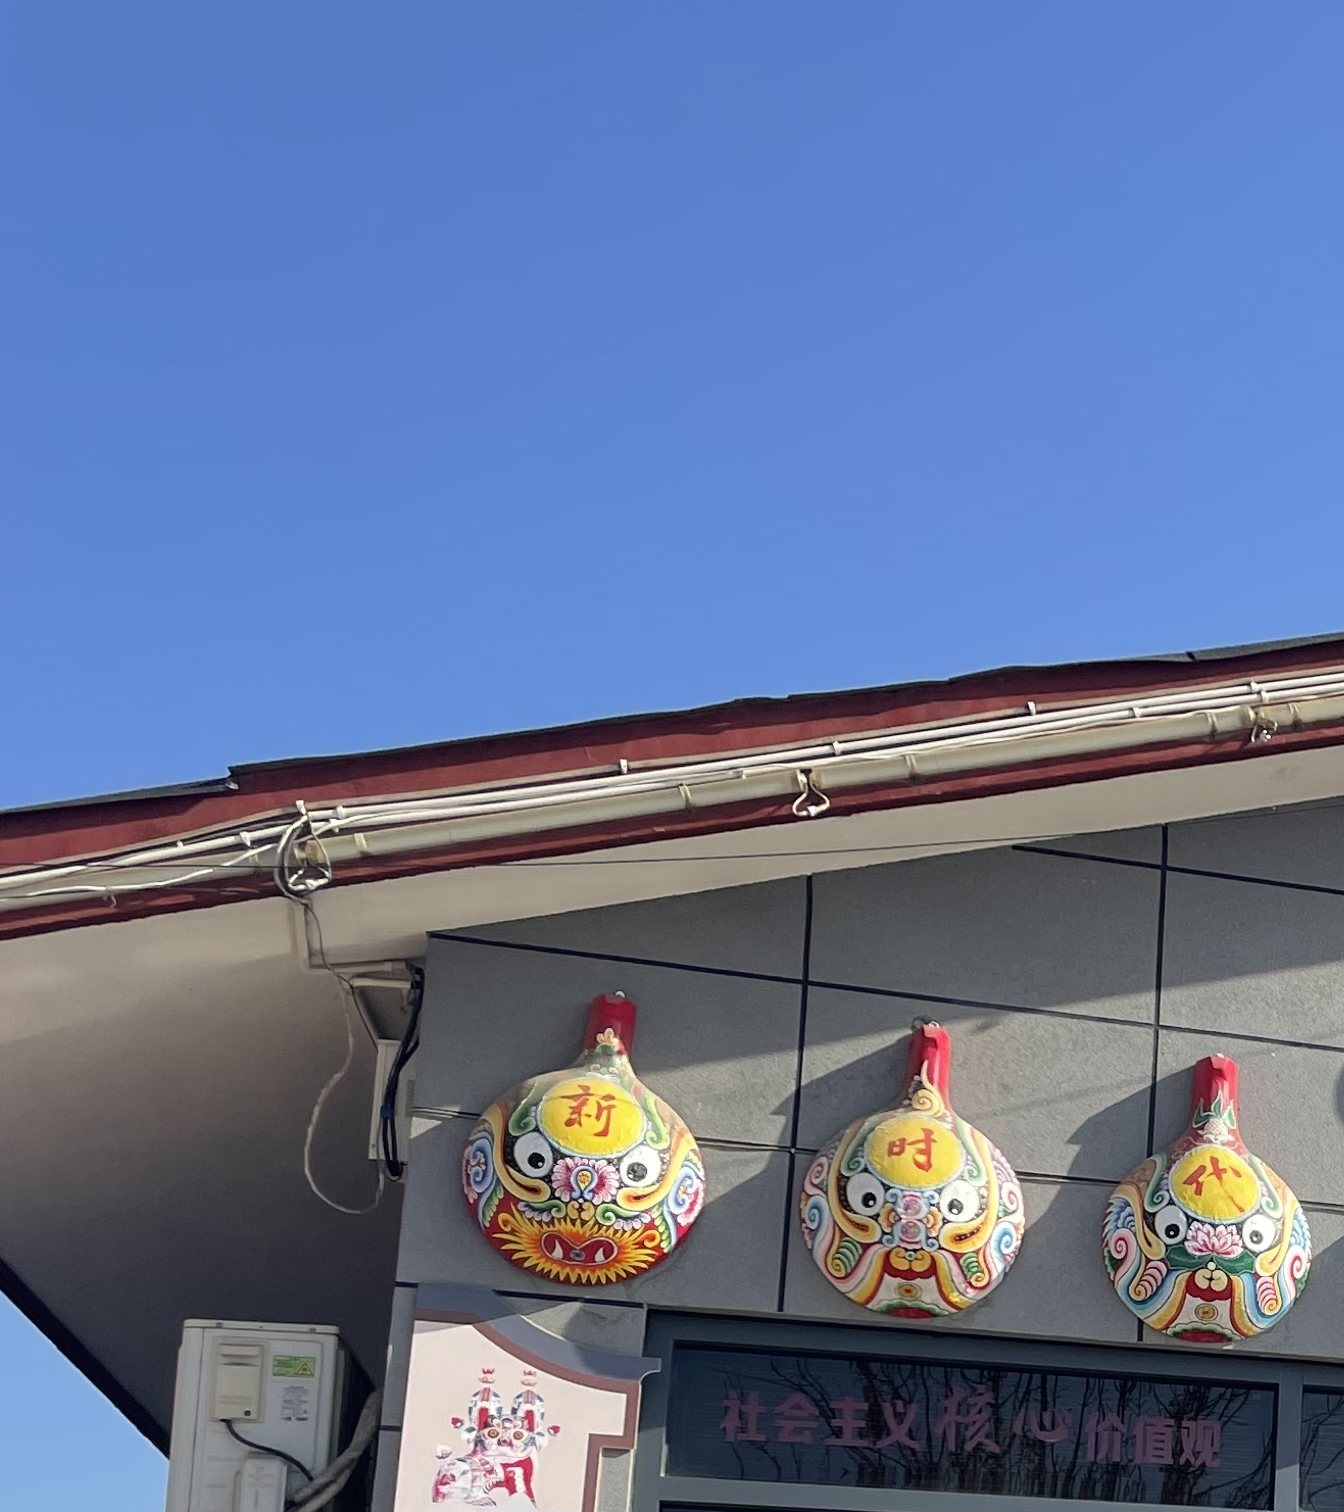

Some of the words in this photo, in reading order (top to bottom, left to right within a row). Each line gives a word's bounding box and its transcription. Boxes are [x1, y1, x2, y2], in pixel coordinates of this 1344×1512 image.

[720, 1385, 1222, 1468] 社会主义核心价值观
